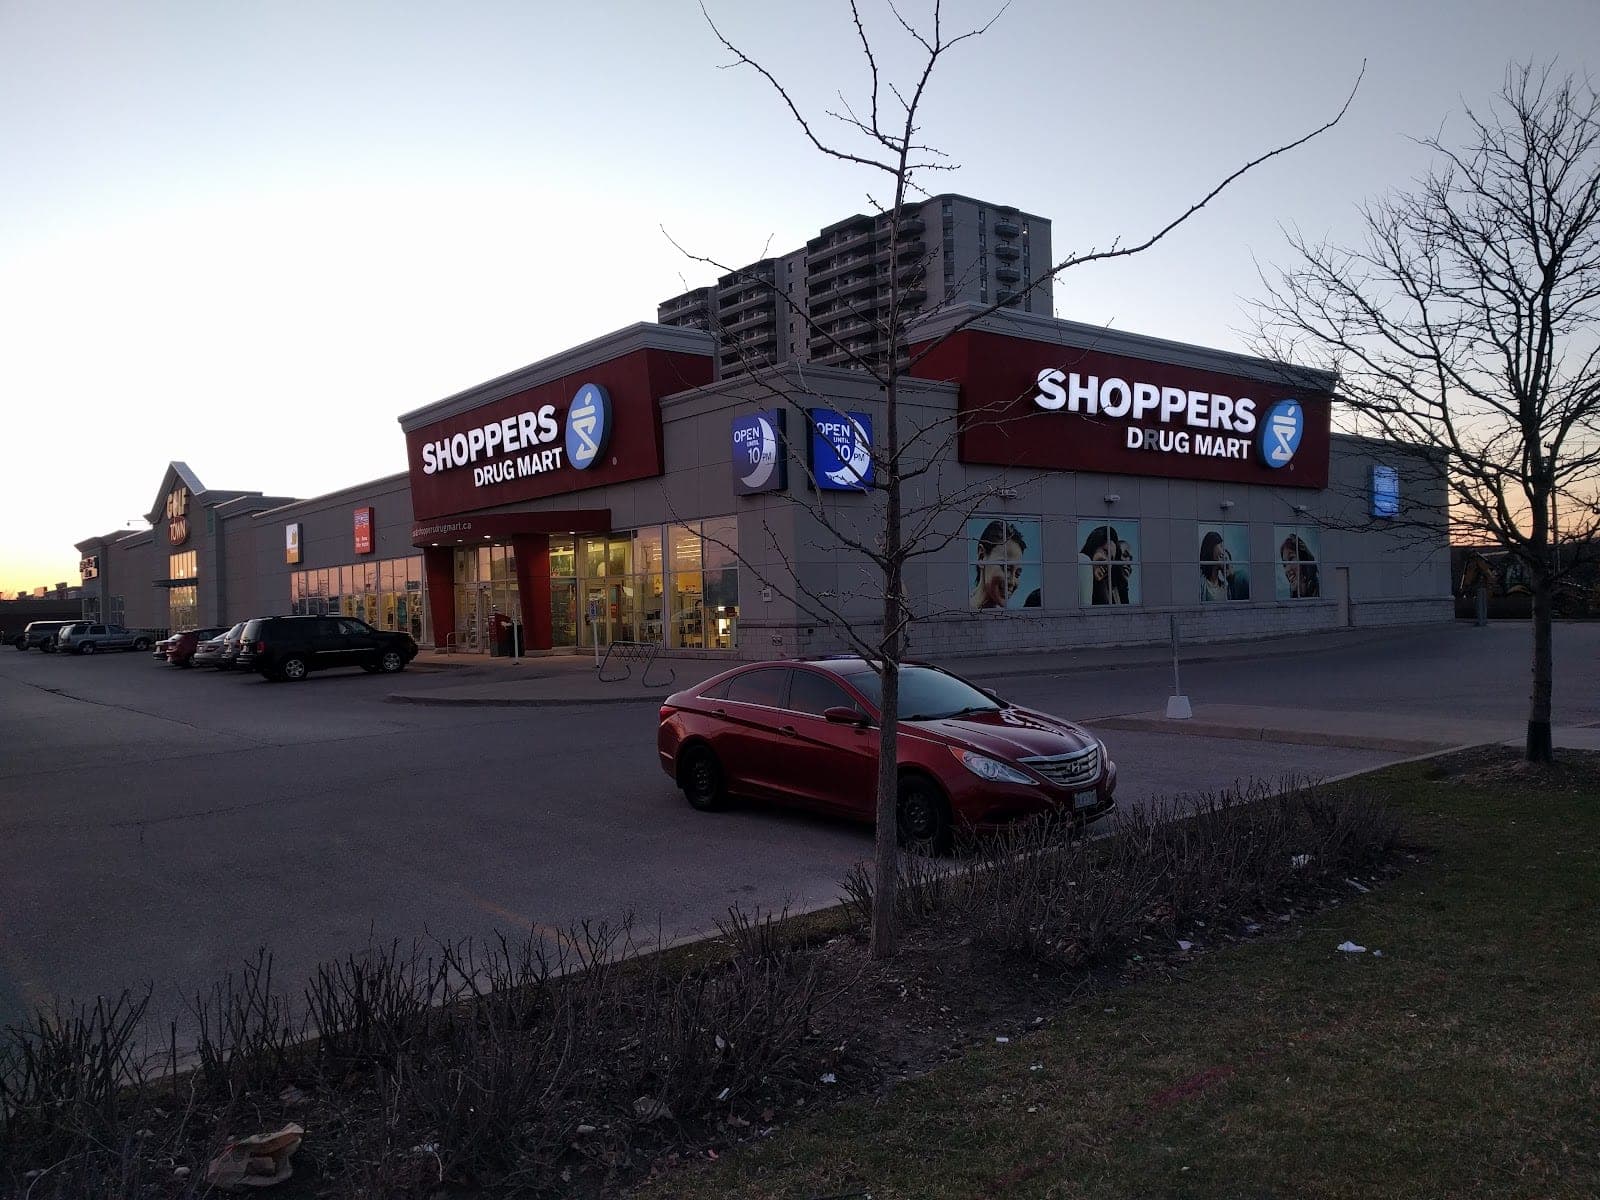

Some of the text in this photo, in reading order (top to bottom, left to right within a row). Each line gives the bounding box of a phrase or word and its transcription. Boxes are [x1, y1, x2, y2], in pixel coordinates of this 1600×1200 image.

[1034, 368, 1257, 433] SHOPPERS
[422, 404, 558, 475] SHOPPERS
[734, 426, 760, 443] OPEN
[816, 422, 850, 437] OPEN
[833, 436, 851, 444] UNTIL
[748, 447, 761, 464] 10
[1127, 427, 1252, 460] DRUG MART
[473, 446, 563, 488] DRUG MART
